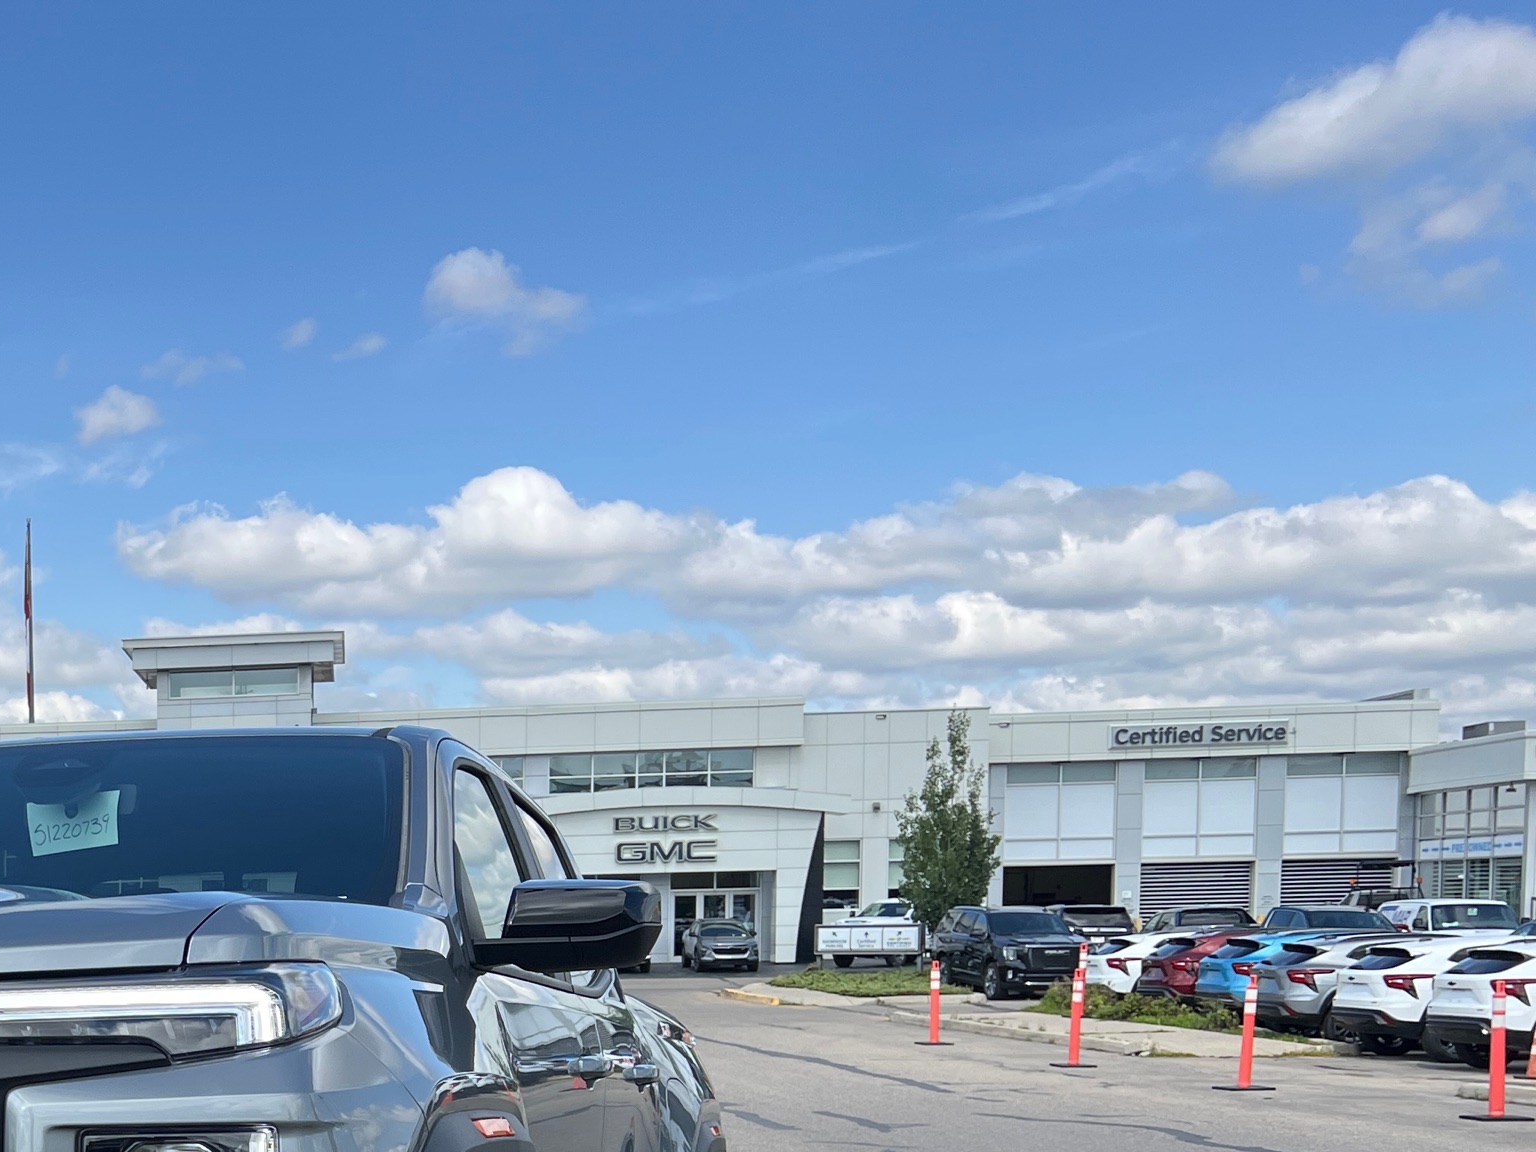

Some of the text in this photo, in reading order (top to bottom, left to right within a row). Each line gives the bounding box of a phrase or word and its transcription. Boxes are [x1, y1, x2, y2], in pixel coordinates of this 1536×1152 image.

[1114, 724, 1287, 745] Certified Service
[613, 814, 719, 833] BUICK
[615, 839, 718, 864] GMC
